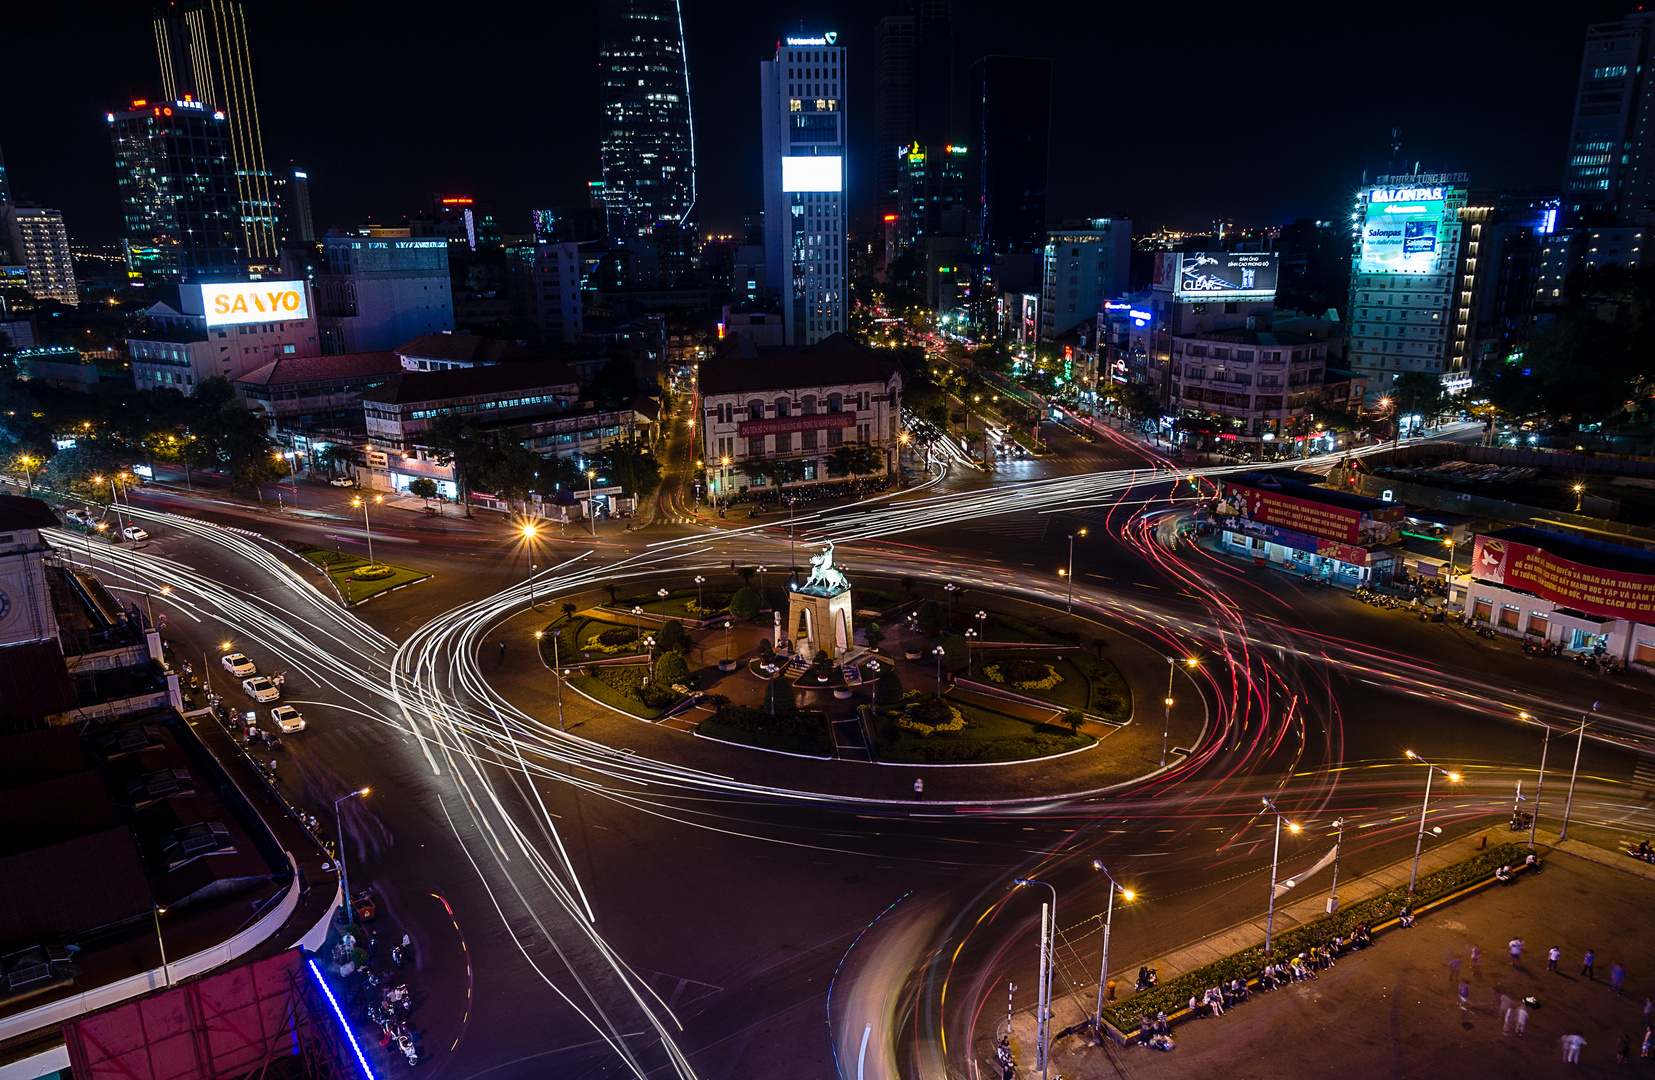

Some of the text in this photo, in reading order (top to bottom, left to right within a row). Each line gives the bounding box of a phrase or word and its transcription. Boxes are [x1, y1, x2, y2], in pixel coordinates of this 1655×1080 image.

[1390, 172, 1468, 184] THIÊN TÙNG HOTEL
[1368, 229, 1402, 238] Salonpas
[1405, 239, 1433, 247] Salonpas
[1183, 279, 1214, 291] CLEAR
[214, 290, 301, 315] SANYO
[1516, 560, 1523, 568] HỒ
[1524, 562, 1534, 570] CHÍ
[1550, 574, 1559, 582] CỰC
[1570, 580, 1588, 590] MẠNH
[1588, 586, 1603, 594] HỌC
[1604, 588, 1618, 598] TẬP
[1620, 590, 1630, 598] VÀ
[1632, 592, 1650, 600] LÀM
[1556, 566, 1572, 576] QUYỀN
[1574, 572, 1581, 580] VÀ
[1582, 574, 1600, 584] NHÂN
[1602, 578, 1617, 586] DÂN
[1618, 580, 1642, 590] THÀNH
[1512, 568, 1520, 576] TƯ
[1558, 586, 1568, 596] ĐẠO
[1568, 590, 1582, 600] ĐỨC,
[1584, 594, 1605, 604] PHONG
[1606, 598, 1625, 608] CÁCH
[1626, 600, 1637, 610] HỒ
[1638, 602, 1651, 612] CHÍ
